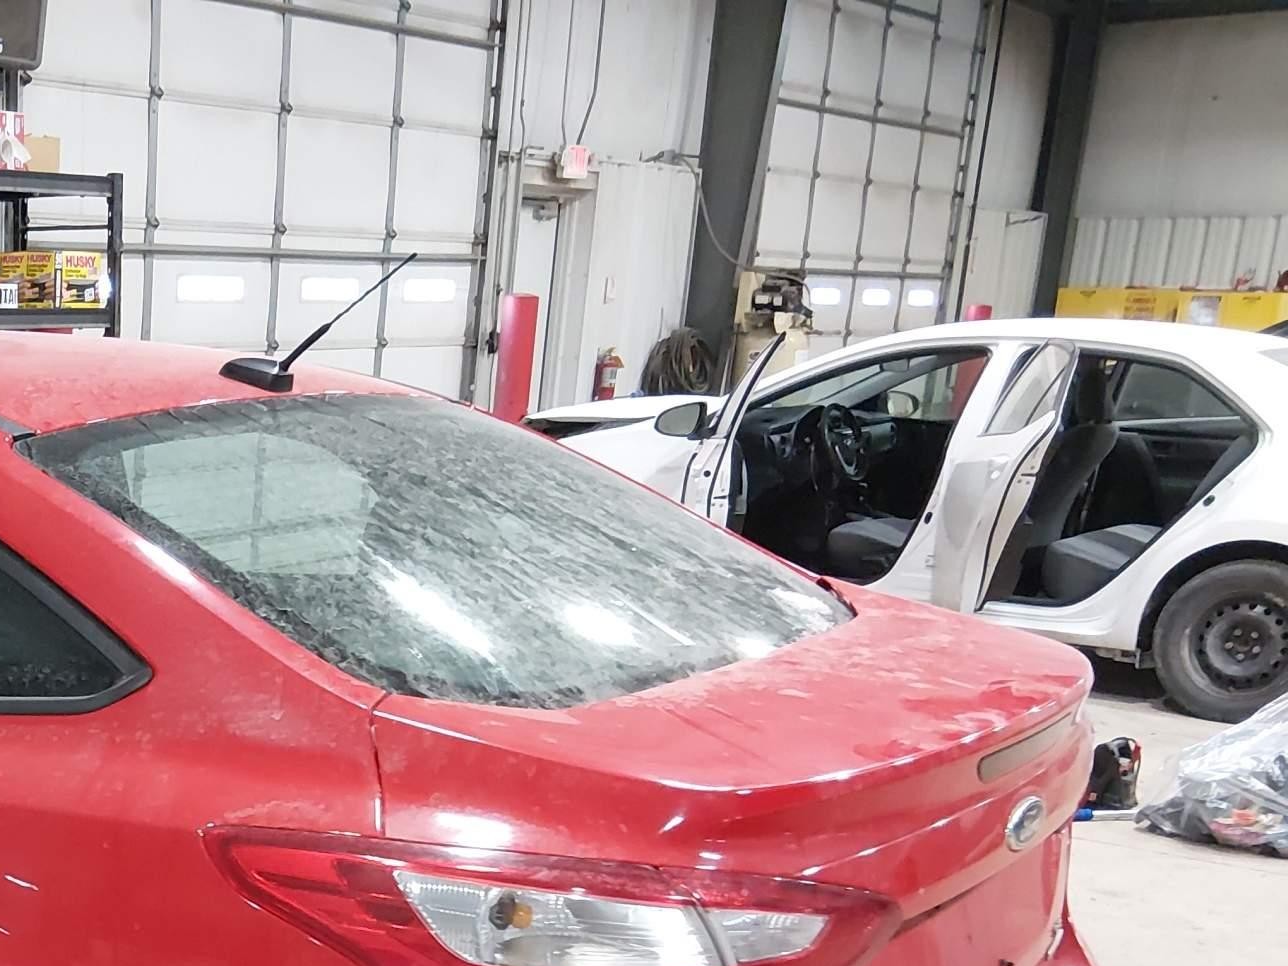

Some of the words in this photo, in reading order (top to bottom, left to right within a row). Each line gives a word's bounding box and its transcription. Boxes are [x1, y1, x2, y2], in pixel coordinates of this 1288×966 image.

[1, 255, 25, 264] HUSKY
[28, 254, 52, 263] HUSKY
[65, 255, 96, 268] HUSKY
